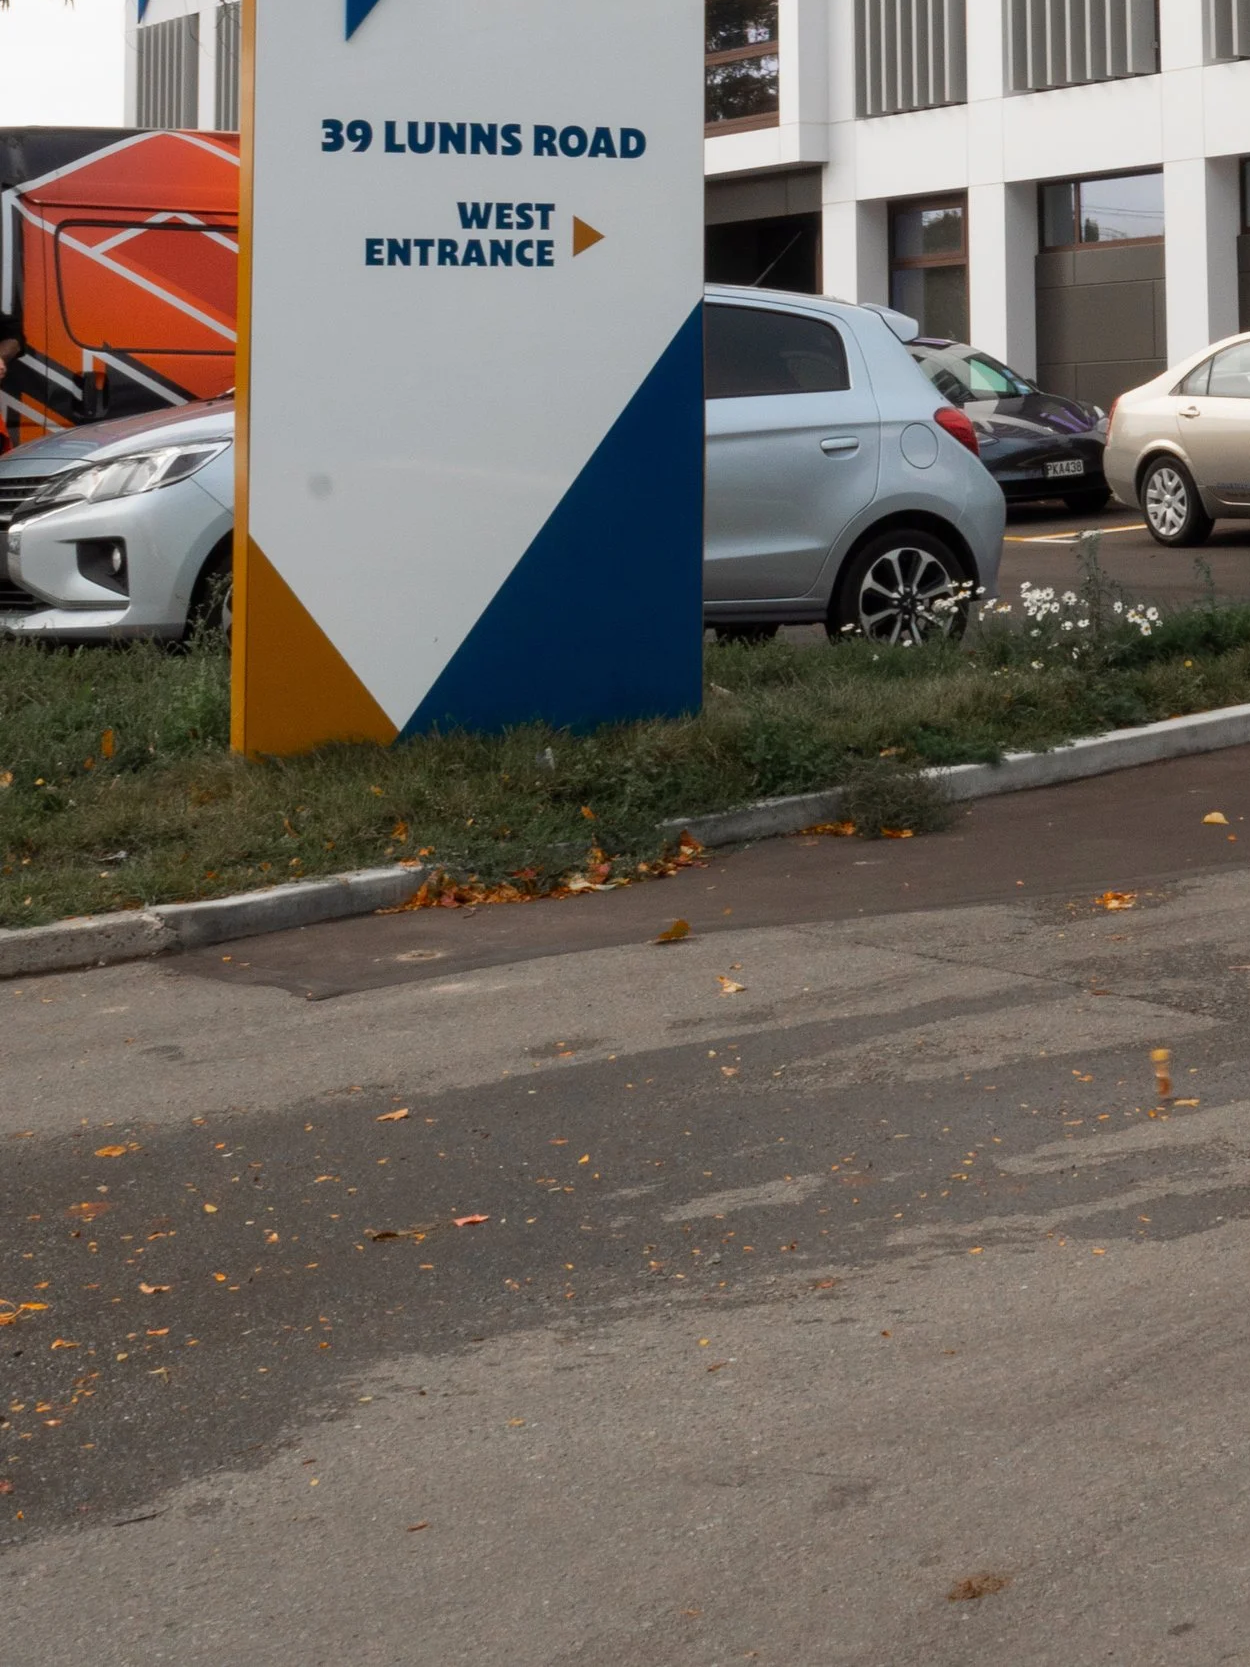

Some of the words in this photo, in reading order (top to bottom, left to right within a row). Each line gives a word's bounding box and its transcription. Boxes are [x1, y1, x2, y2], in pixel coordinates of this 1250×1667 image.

[321, 118, 373, 153] 39
[384, 120, 523, 156] LUNNS
[533, 124, 647, 159] ROAD
[457, 201, 556, 230] WEST
[365, 238, 555, 267] ENTRANCE
